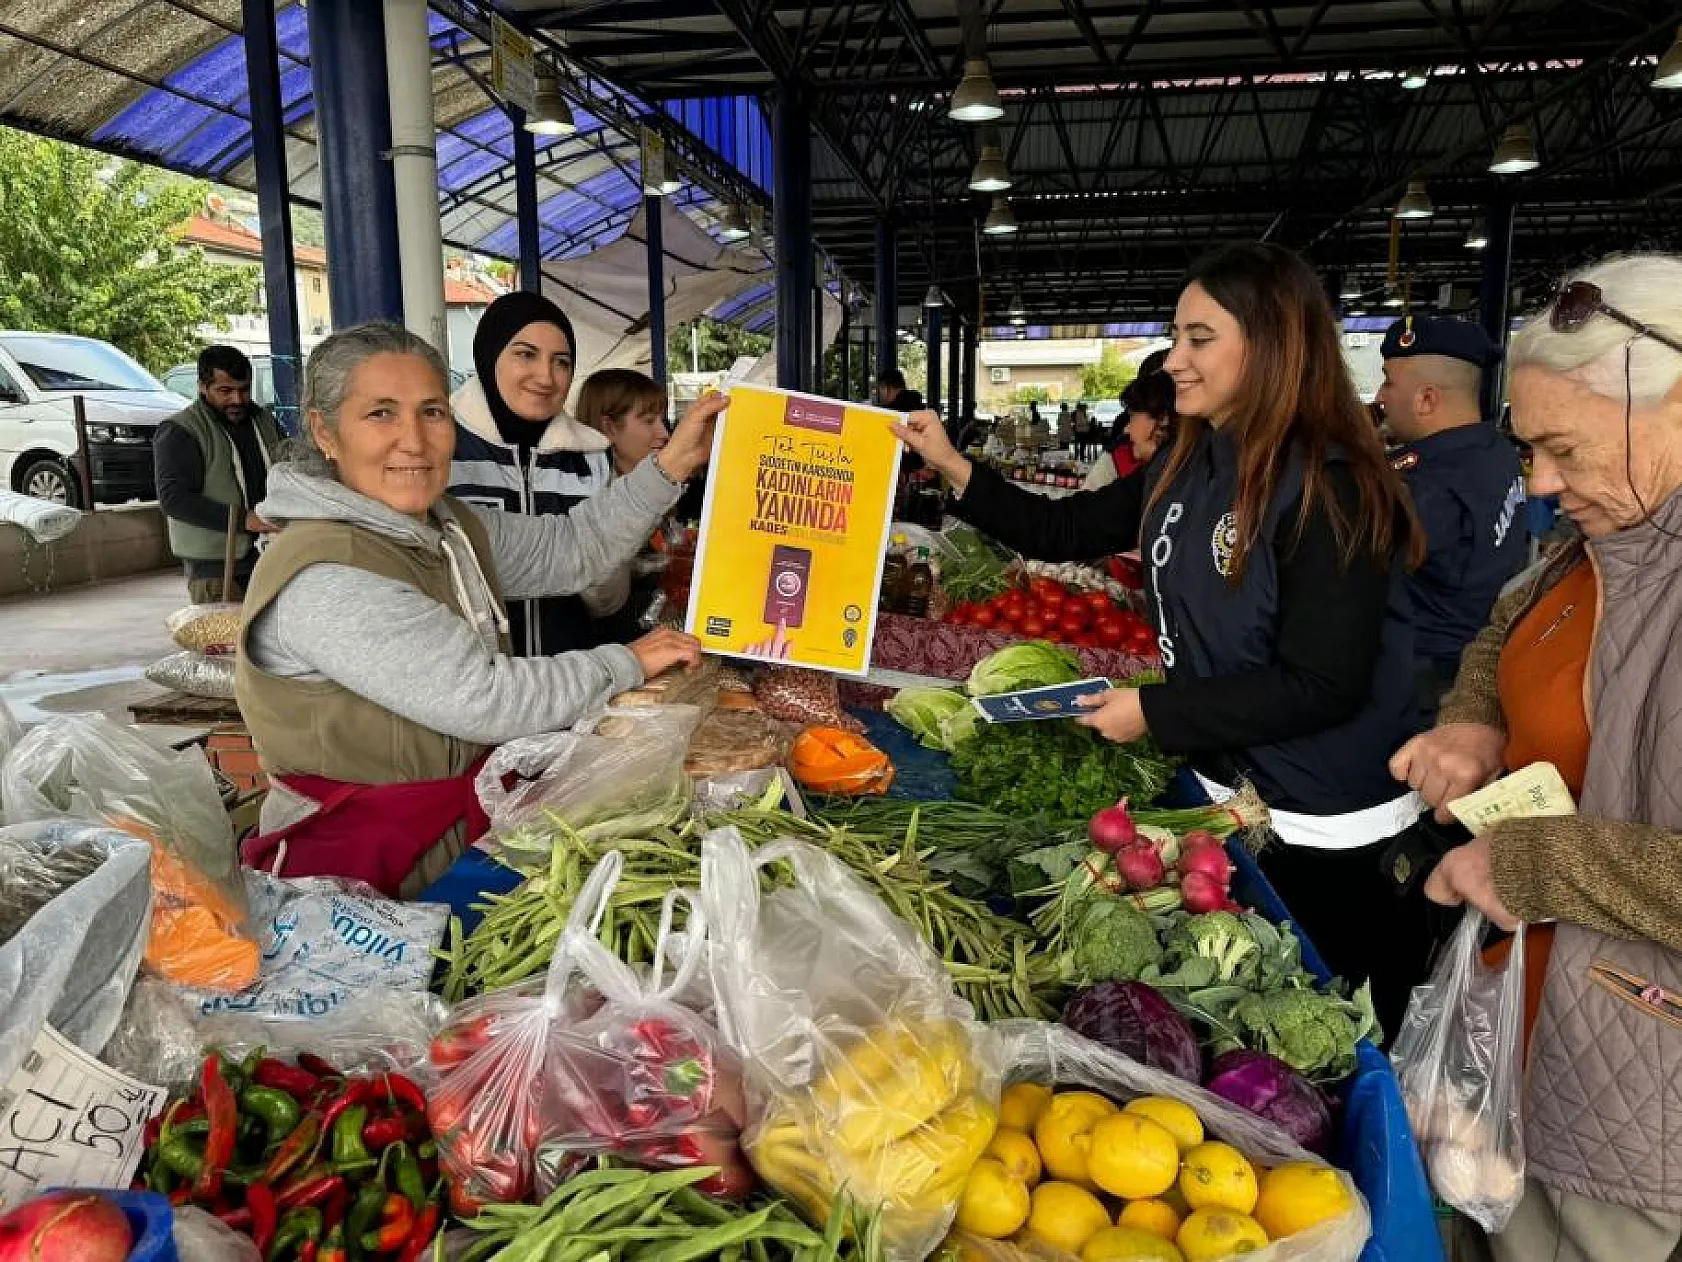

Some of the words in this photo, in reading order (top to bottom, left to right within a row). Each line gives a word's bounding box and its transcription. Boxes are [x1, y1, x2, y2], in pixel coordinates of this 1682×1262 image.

[757, 467, 853, 504] KADINLARIN
[756, 489, 847, 533] YANINDA
[72, 1093, 131, 1159] 50
